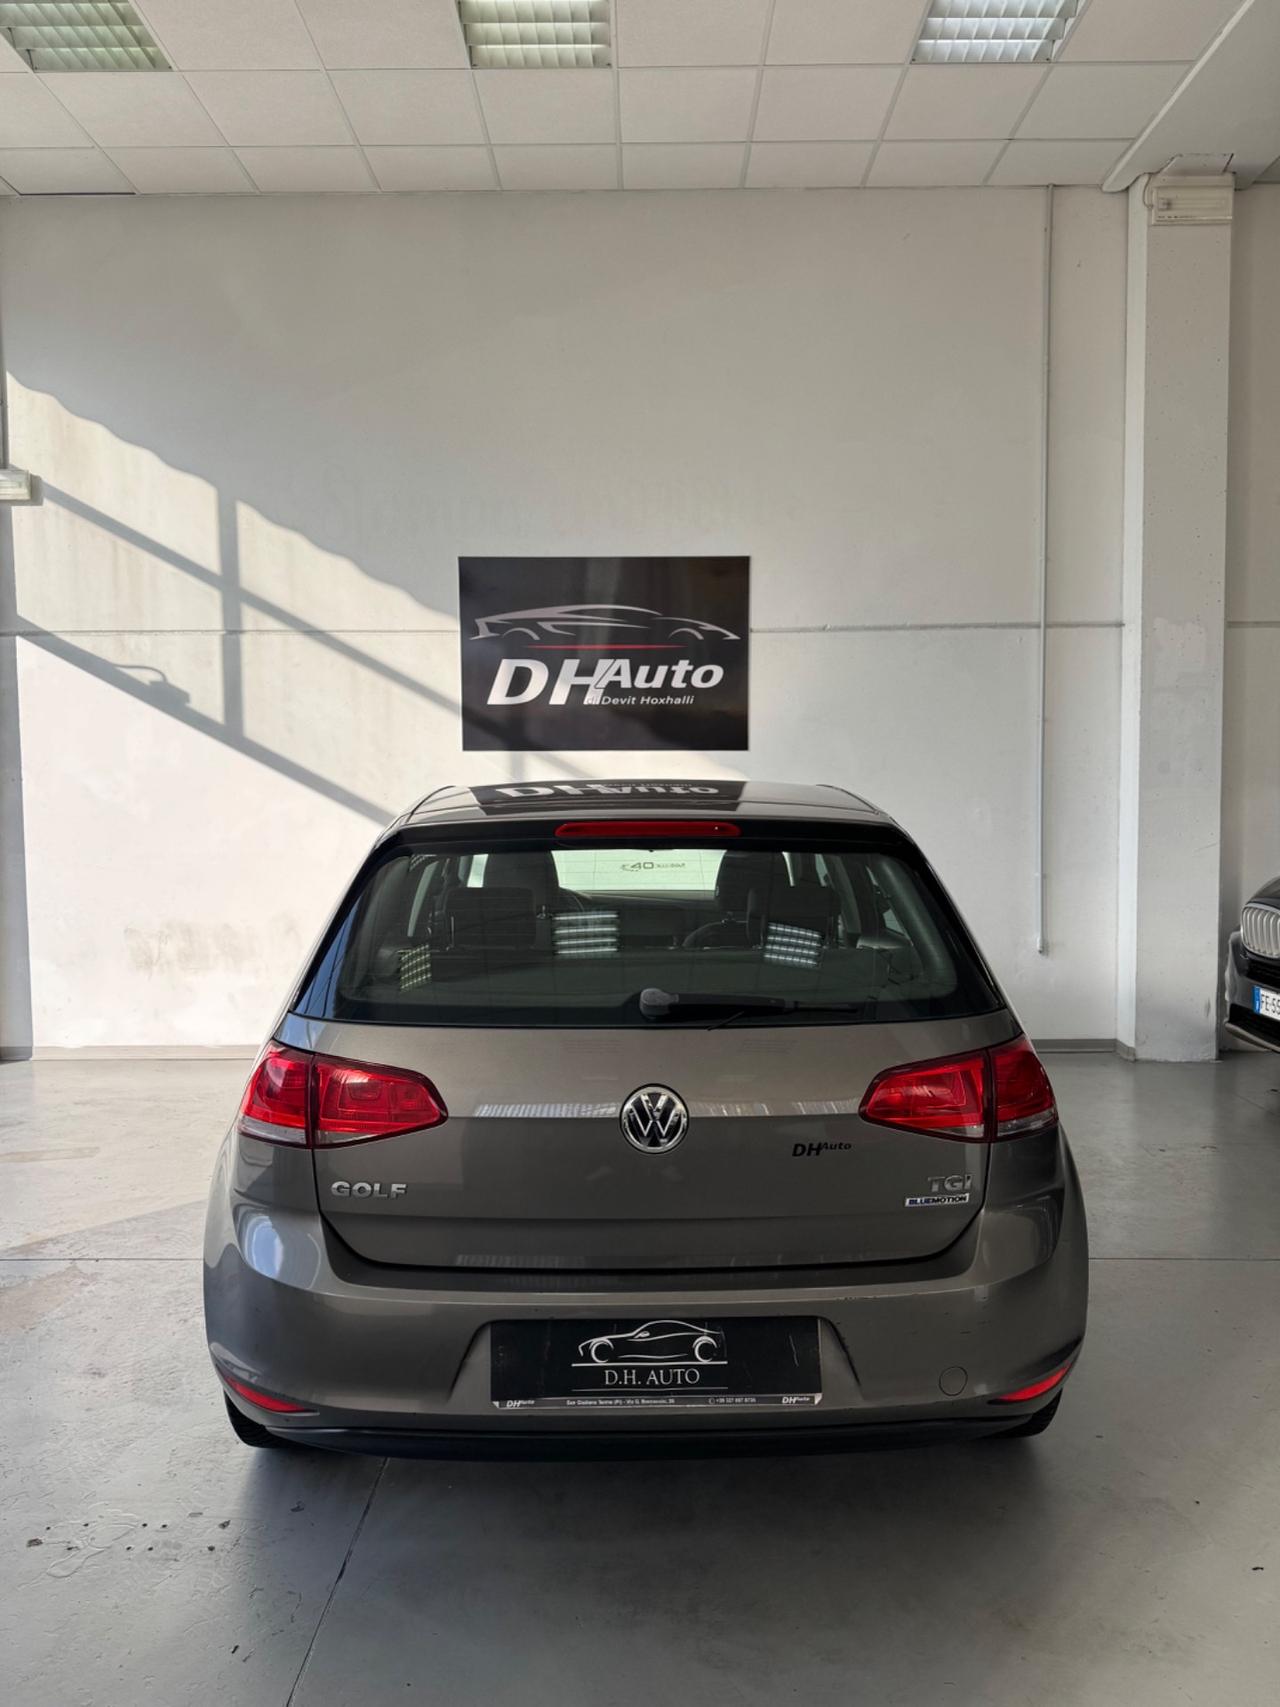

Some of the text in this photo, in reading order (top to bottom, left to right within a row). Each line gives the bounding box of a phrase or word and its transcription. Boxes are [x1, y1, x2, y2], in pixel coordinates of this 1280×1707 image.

[602, 695, 635, 706] Devit
[640, 695, 694, 706] Hoxhalli
[330, 1180, 407, 1199] GOLF
[928, 1174, 973, 1193] TGI
[908, 1195, 967, 1206] BLUEMOTION
[604, 1367, 700, 1385] D.H. AUTO
